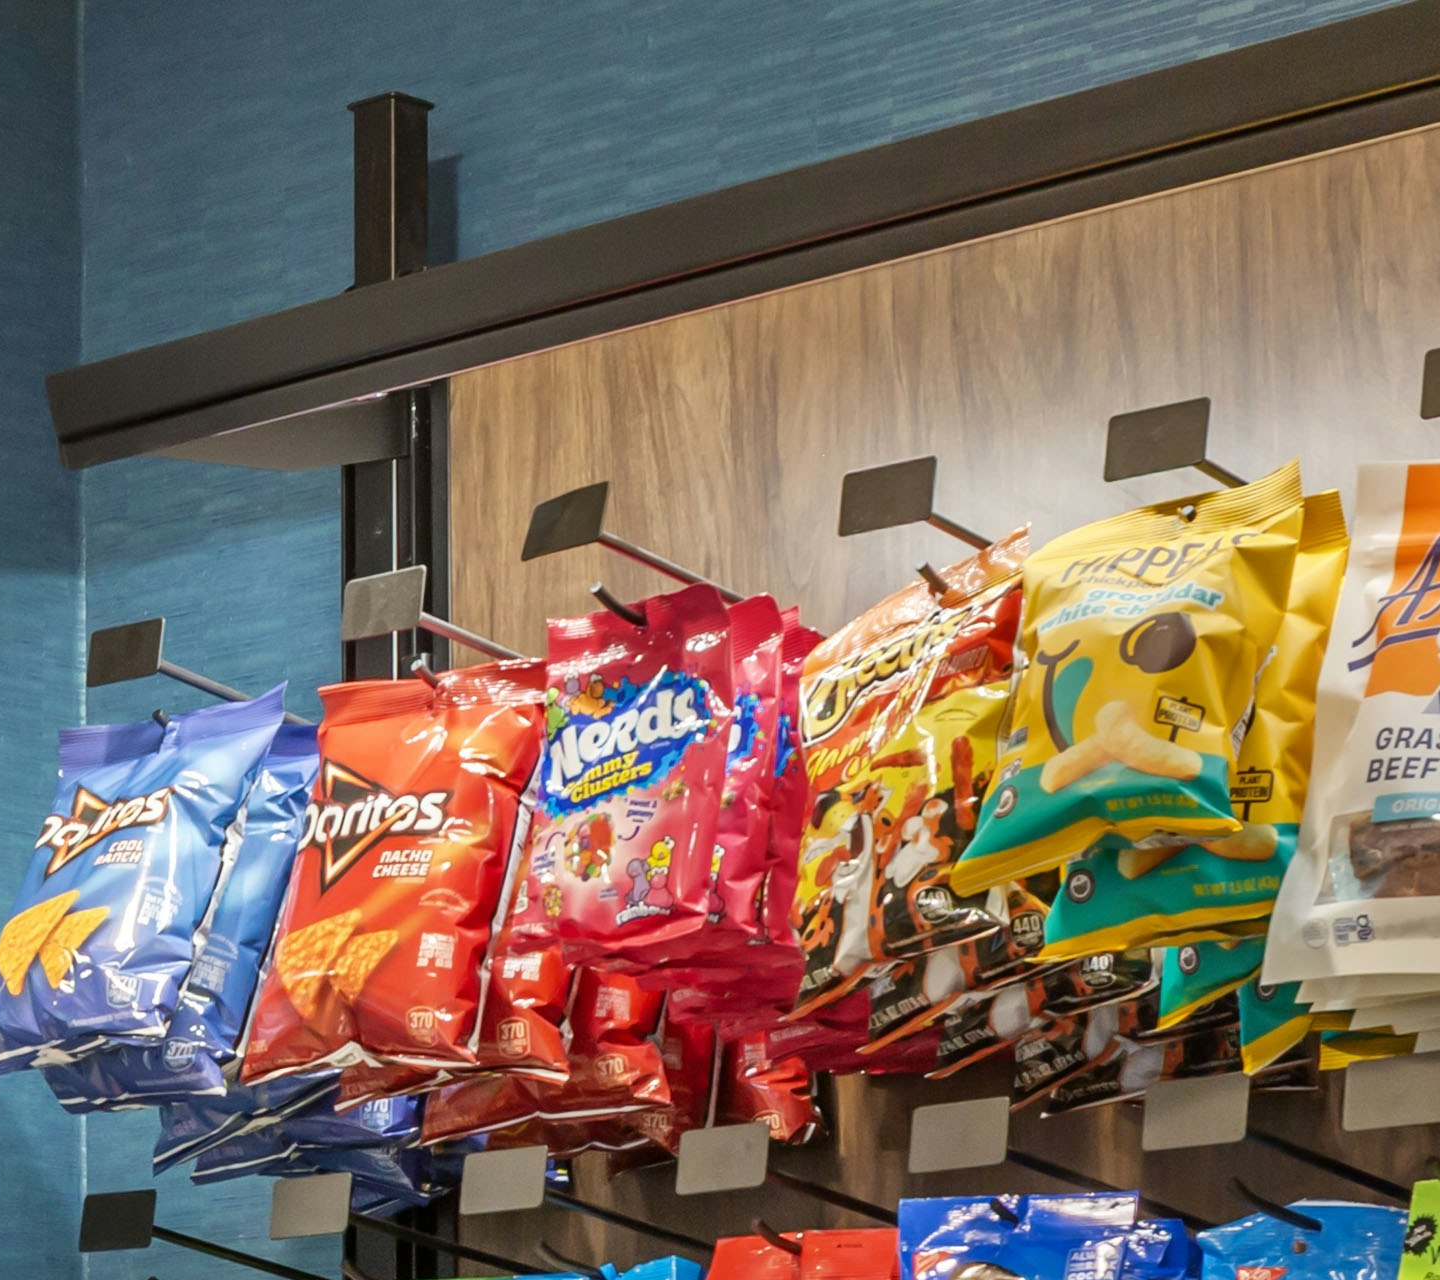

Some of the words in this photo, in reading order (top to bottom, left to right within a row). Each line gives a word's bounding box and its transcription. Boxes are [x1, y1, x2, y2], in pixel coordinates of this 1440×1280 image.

[1366, 757, 1440, 784] BEEF
[297, 792, 449, 850] Doritos
[109, 839, 144, 853] COOL
[379, 850, 432, 864] NACHO
[372, 862, 430, 877] CHEESE
[1013, 915, 1041, 934] 440
[1083, 955, 1111, 972] 440
[406, 1012, 434, 1032] 370
[500, 1020, 526, 1041] 370
